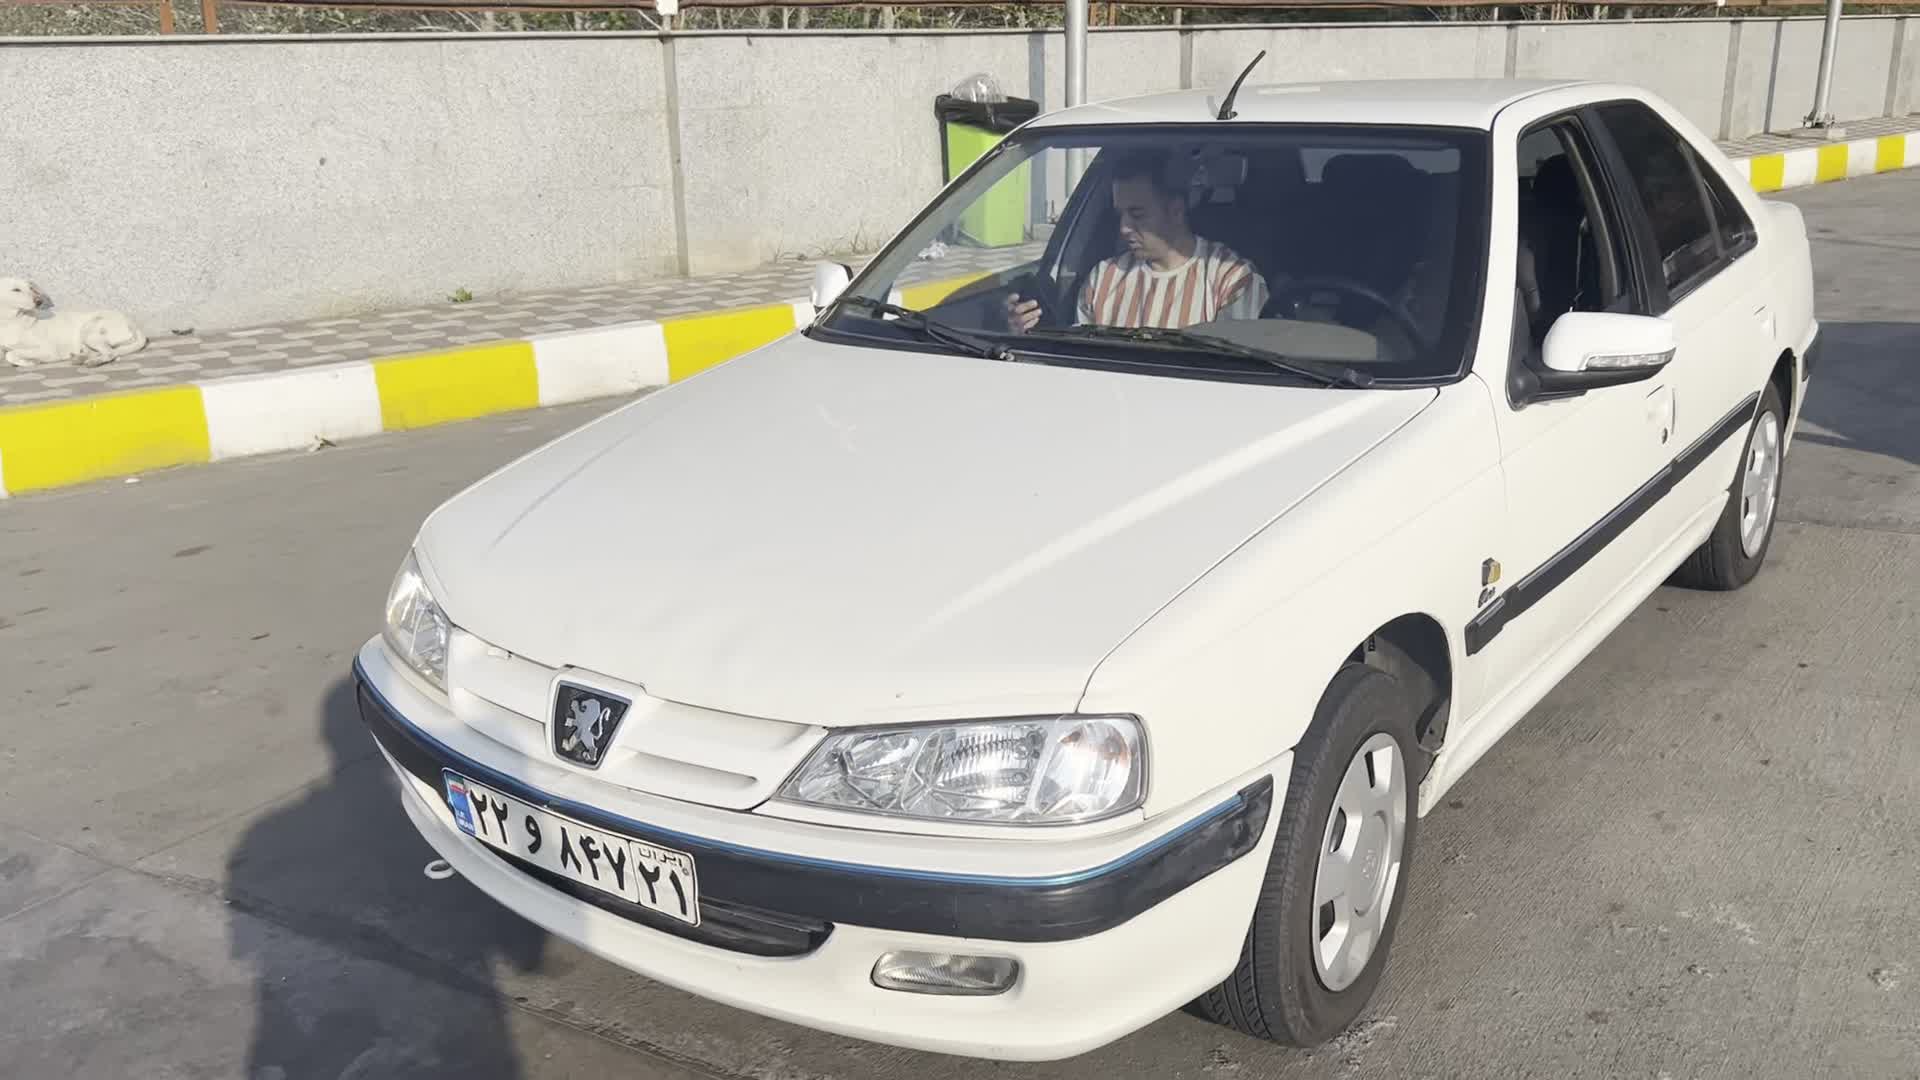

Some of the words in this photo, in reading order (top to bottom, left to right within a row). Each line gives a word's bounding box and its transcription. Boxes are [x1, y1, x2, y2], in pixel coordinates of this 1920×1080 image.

[470, 790, 508, 845] ۲۲
[525, 814, 542, 855] و
[560, 826, 626, 891] ۸۴۷
[638, 861, 687, 916] ۲۱
[639, 848, 682, 868] ایران
